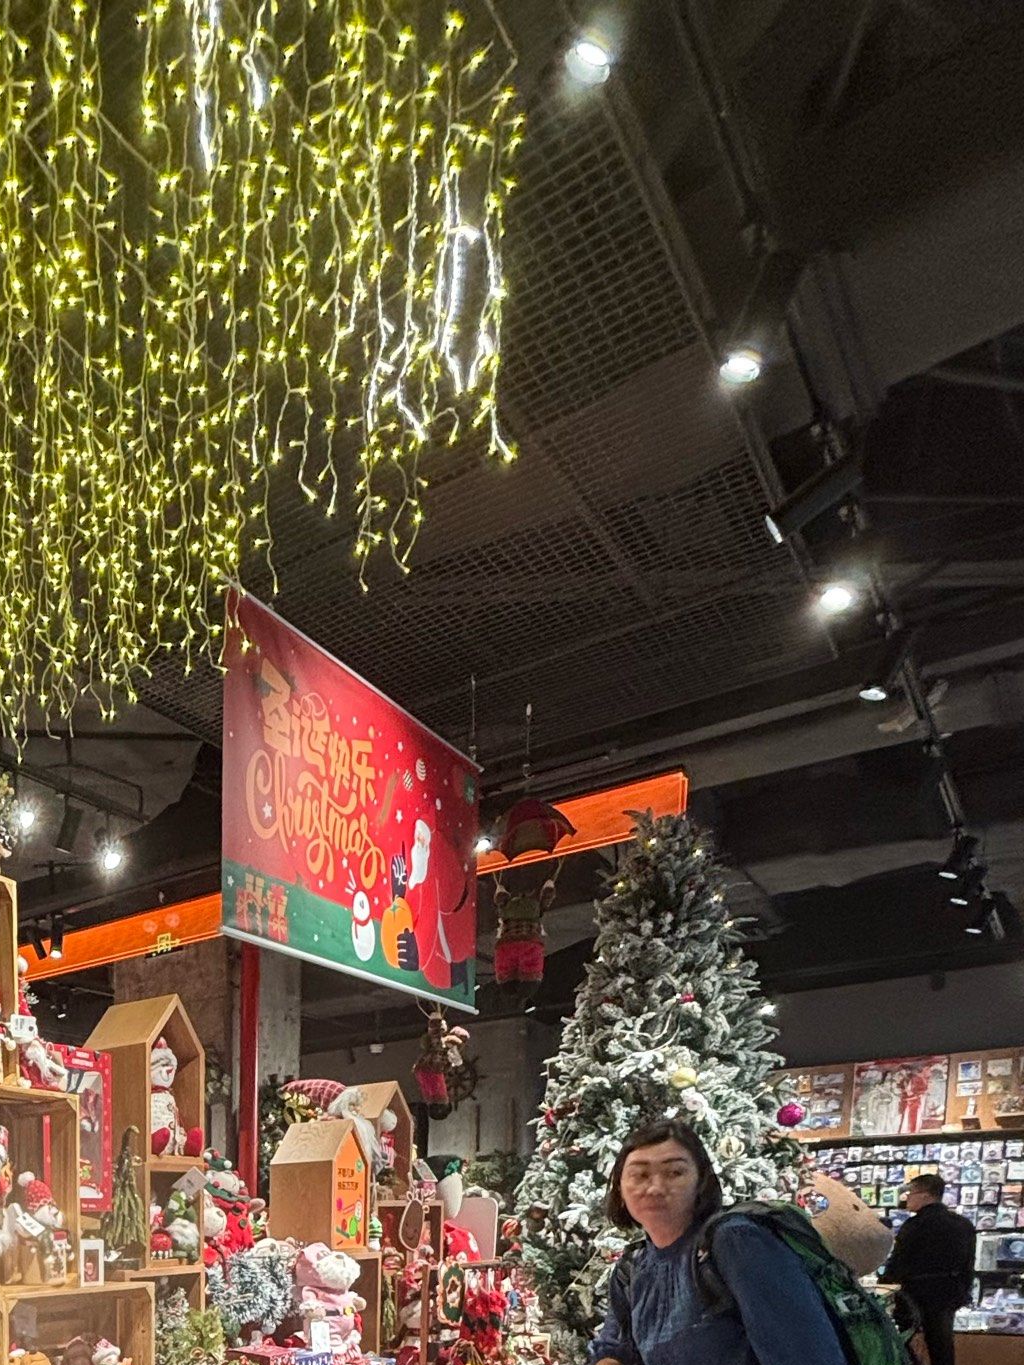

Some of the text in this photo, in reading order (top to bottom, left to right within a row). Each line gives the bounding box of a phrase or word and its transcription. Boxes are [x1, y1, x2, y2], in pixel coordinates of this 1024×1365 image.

[260, 658, 376, 804] 圣诞快乐
[245, 748, 386, 890] Christmas
